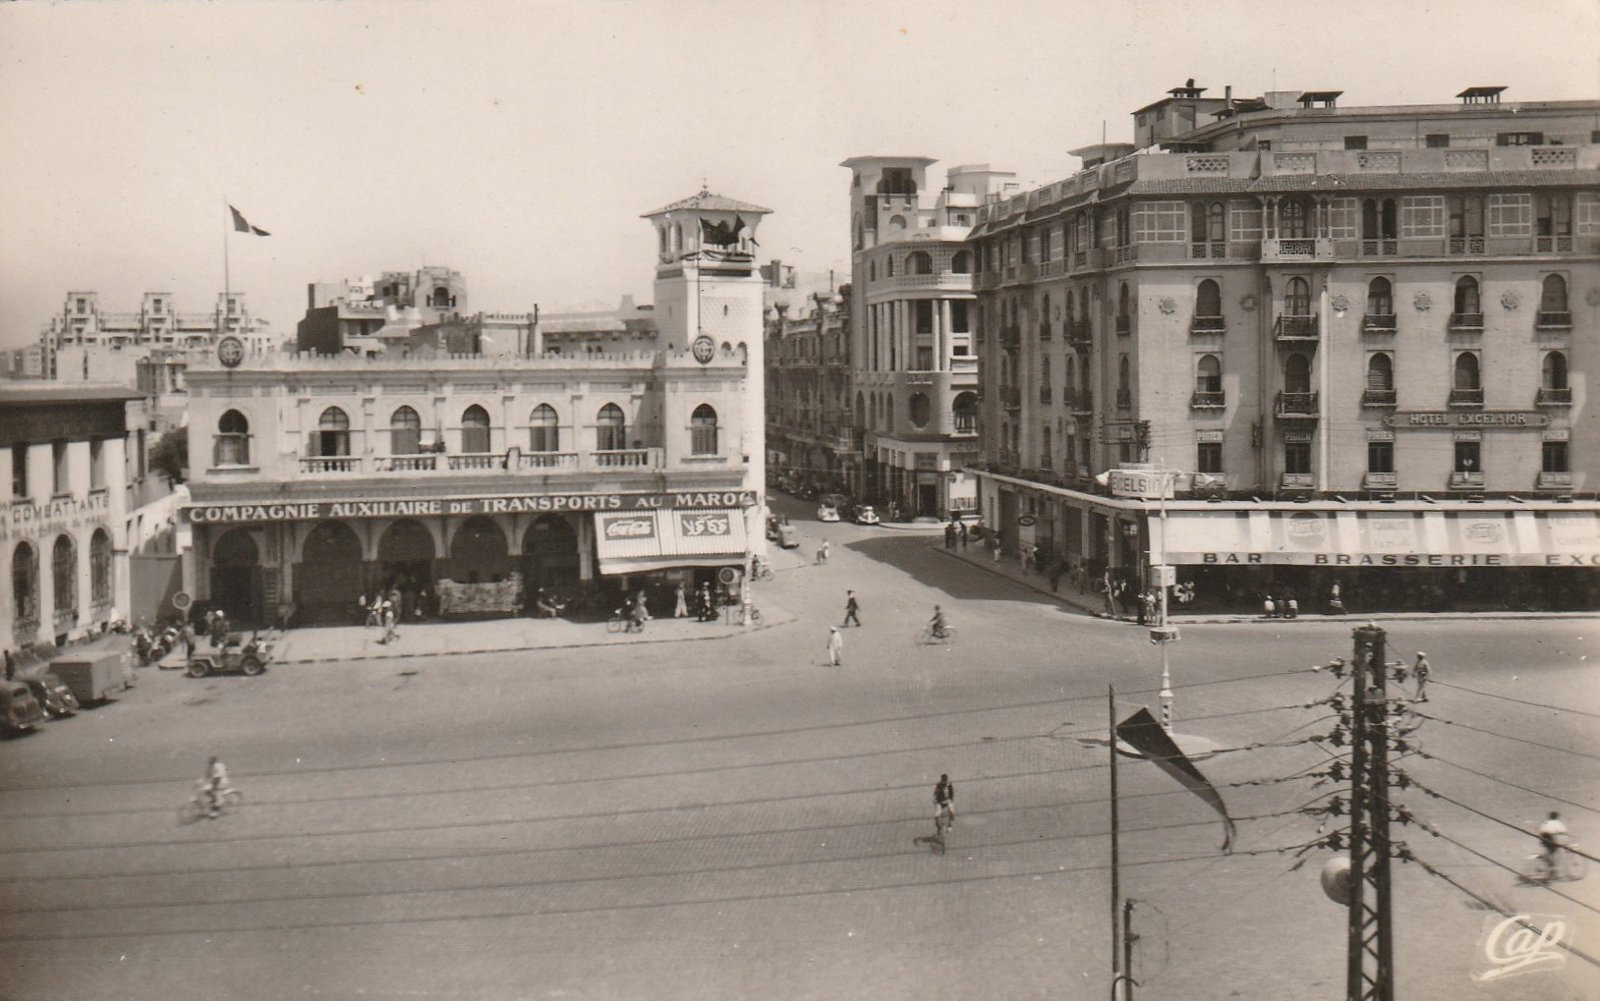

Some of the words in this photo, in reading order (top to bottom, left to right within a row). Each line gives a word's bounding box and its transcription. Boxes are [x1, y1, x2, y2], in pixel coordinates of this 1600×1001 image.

[1409, 413, 1448, 425] HOTEL
[1459, 413, 1526, 425] EXCELSIOR
[189, 503, 321, 522] COMPAGNIE
[329, 500, 442, 517] AUXILIAIRE
[450, 501, 472, 514] DE
[480, 495, 621, 513] TRANSPORTS
[635, 497, 663, 508] AU
[675, 492, 756, 507] MAROC
[1203, 552, 1264, 564] BAR
[1315, 553, 1501, 566] BRASSERIE
